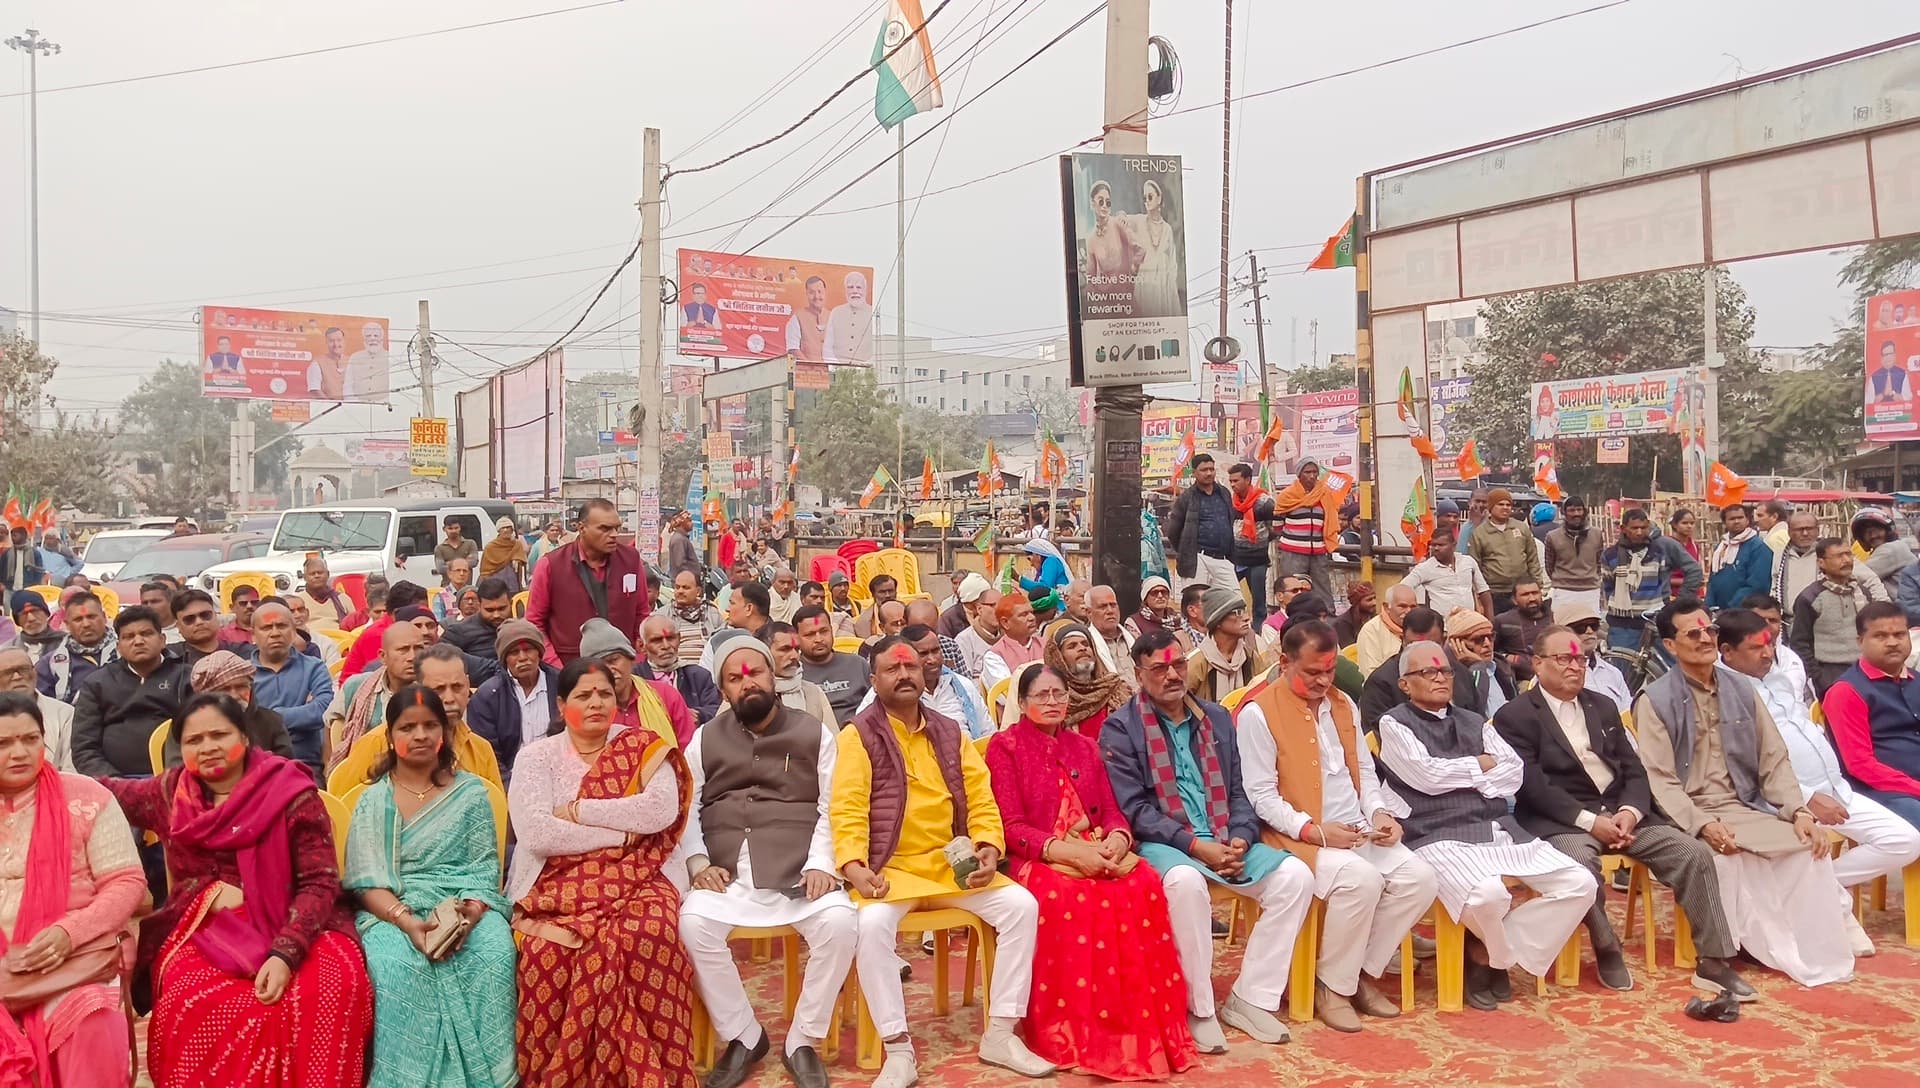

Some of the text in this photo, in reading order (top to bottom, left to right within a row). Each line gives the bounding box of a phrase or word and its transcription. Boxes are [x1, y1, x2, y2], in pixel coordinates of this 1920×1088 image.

[1122, 158, 1177, 173] TRENDS
[1086, 273, 1118, 285] Festive
[1087, 291, 1132, 301] Now more
[1640, 377, 1666, 400] मेला
